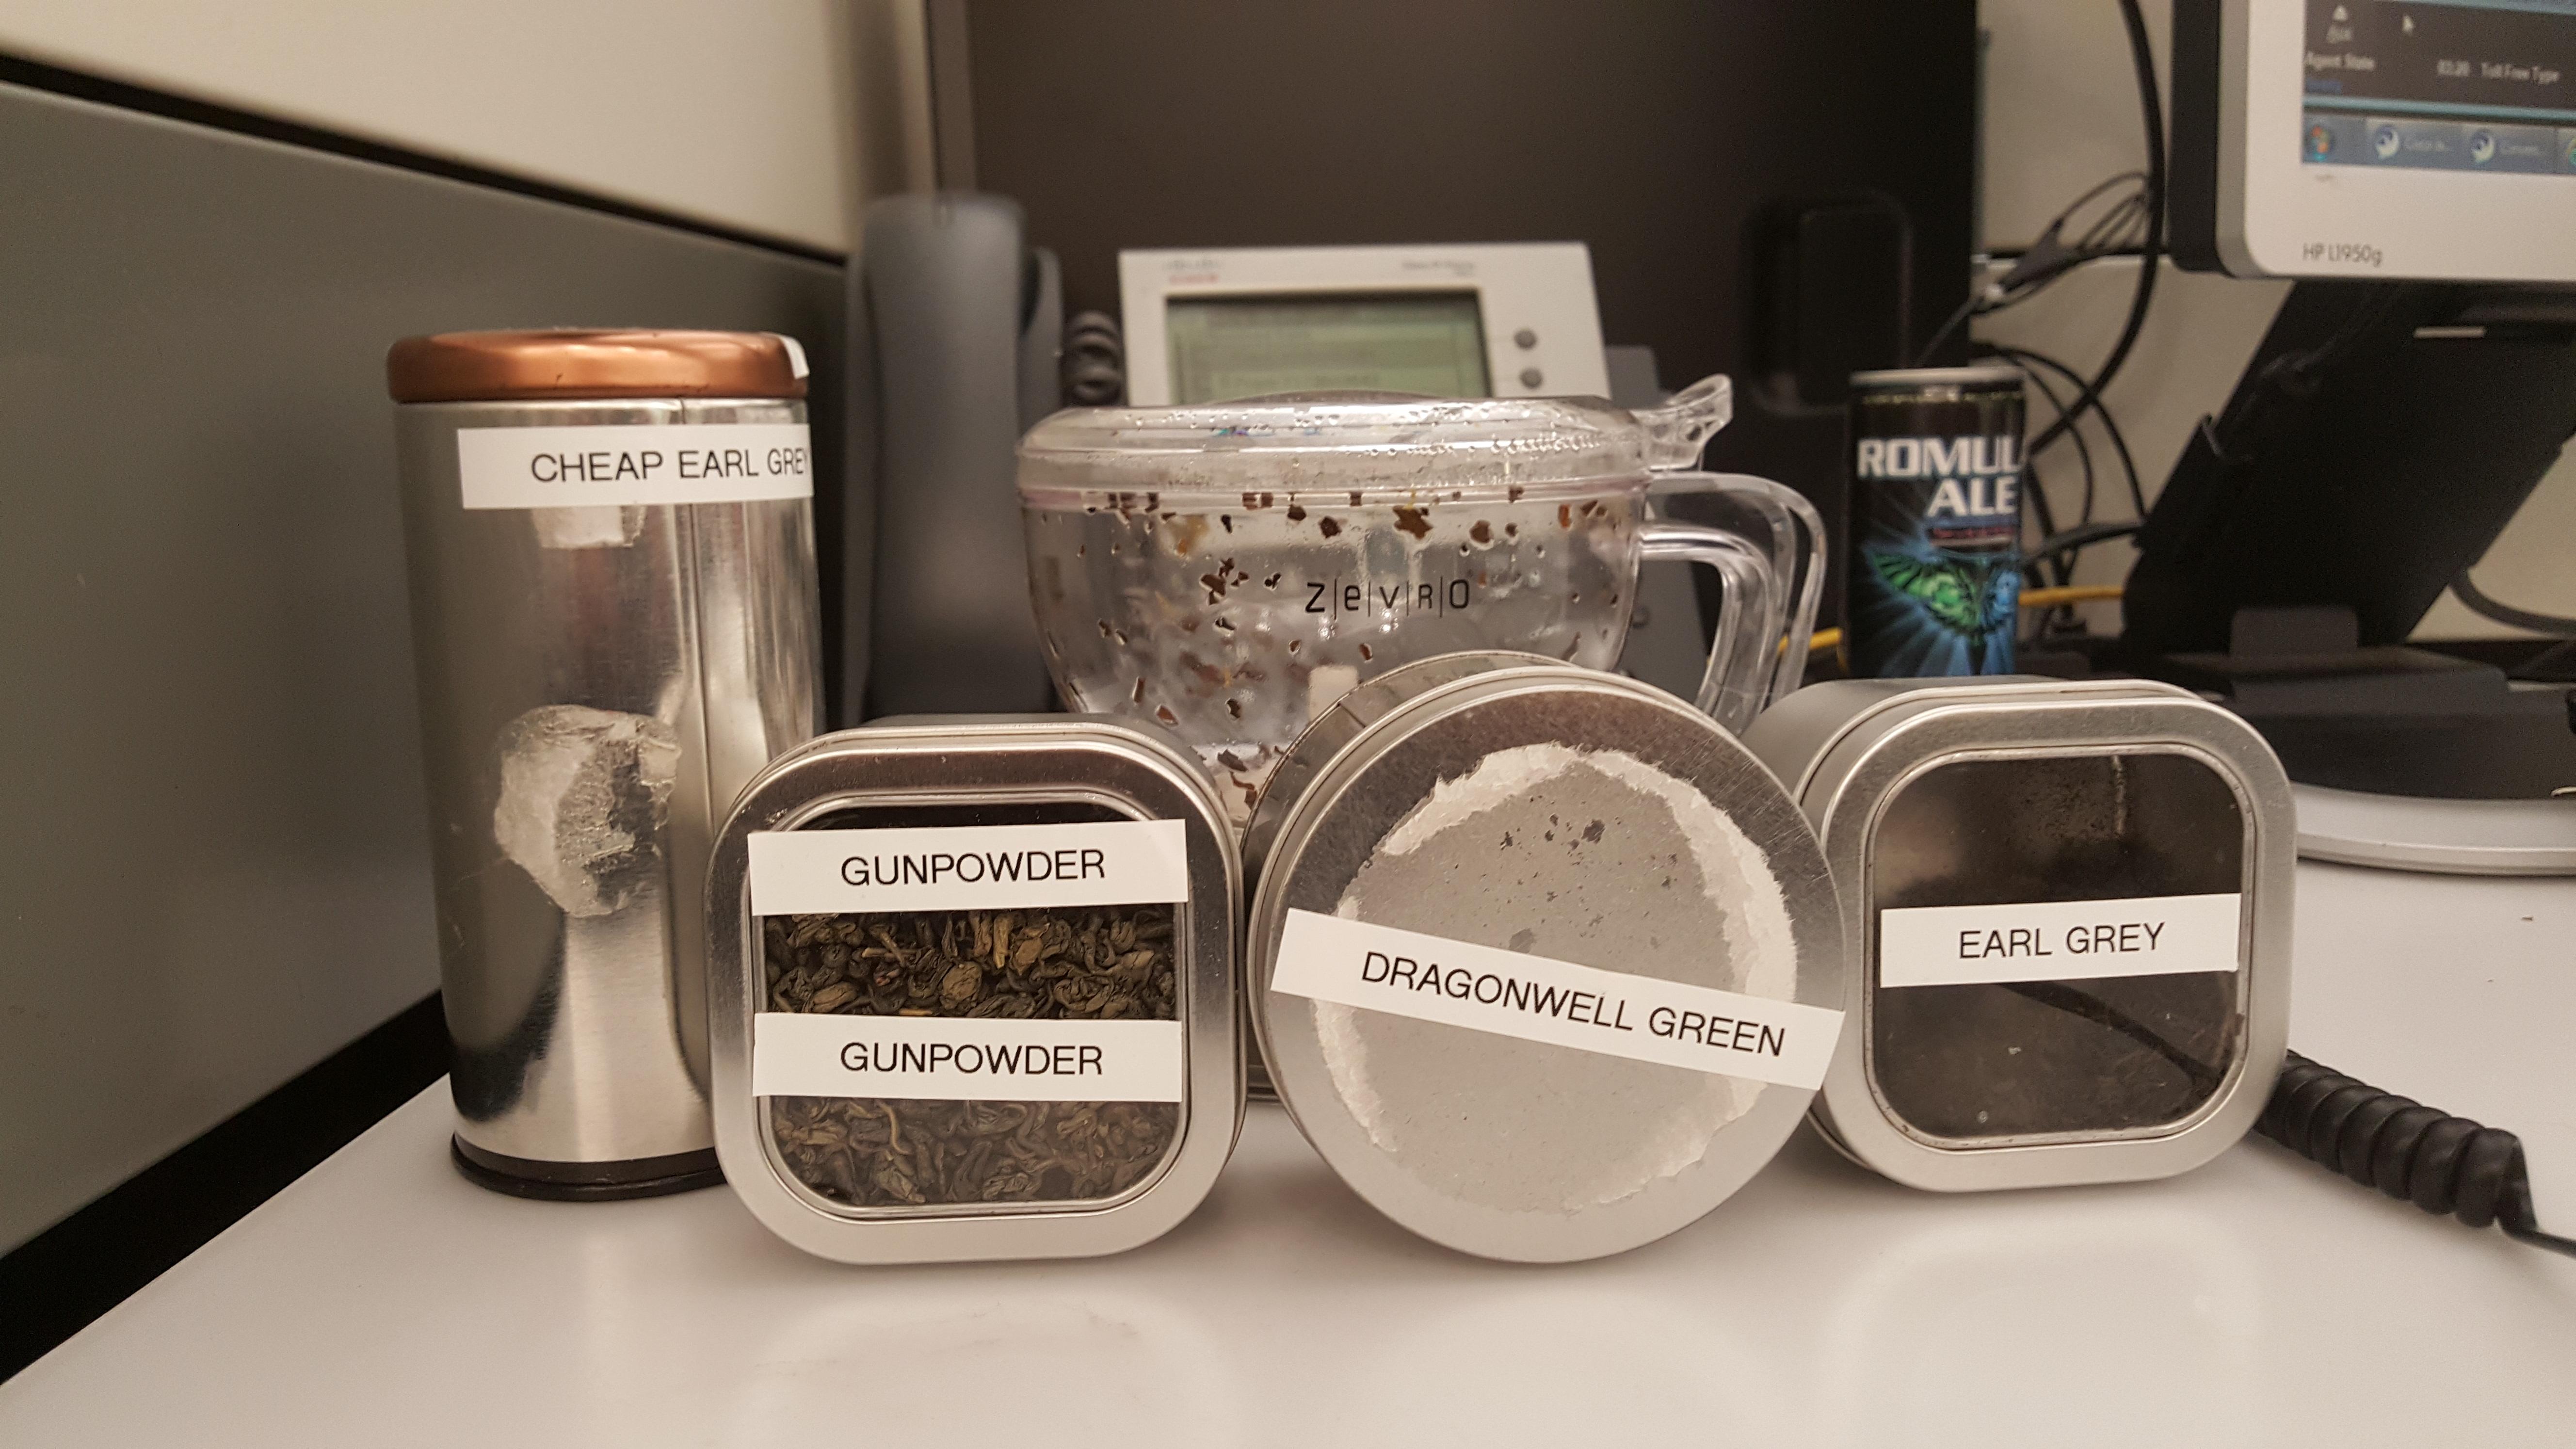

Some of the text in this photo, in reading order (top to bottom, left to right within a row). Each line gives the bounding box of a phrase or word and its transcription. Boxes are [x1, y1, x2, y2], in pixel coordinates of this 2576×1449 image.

[2302, 242, 2383, 267] HP L1950g
[531, 451, 663, 483] CHEAP
[678, 449, 759, 479] EARL
[1926, 476, 2017, 517] ALE
[841, 849, 1105, 886] GUNPOWDER
[1960, 922, 2165, 959] EARL GREY
[1361, 951, 1785, 1057] DRAGONWELL GREEN
[840, 1042, 1102, 1075] GUNPOWDER
